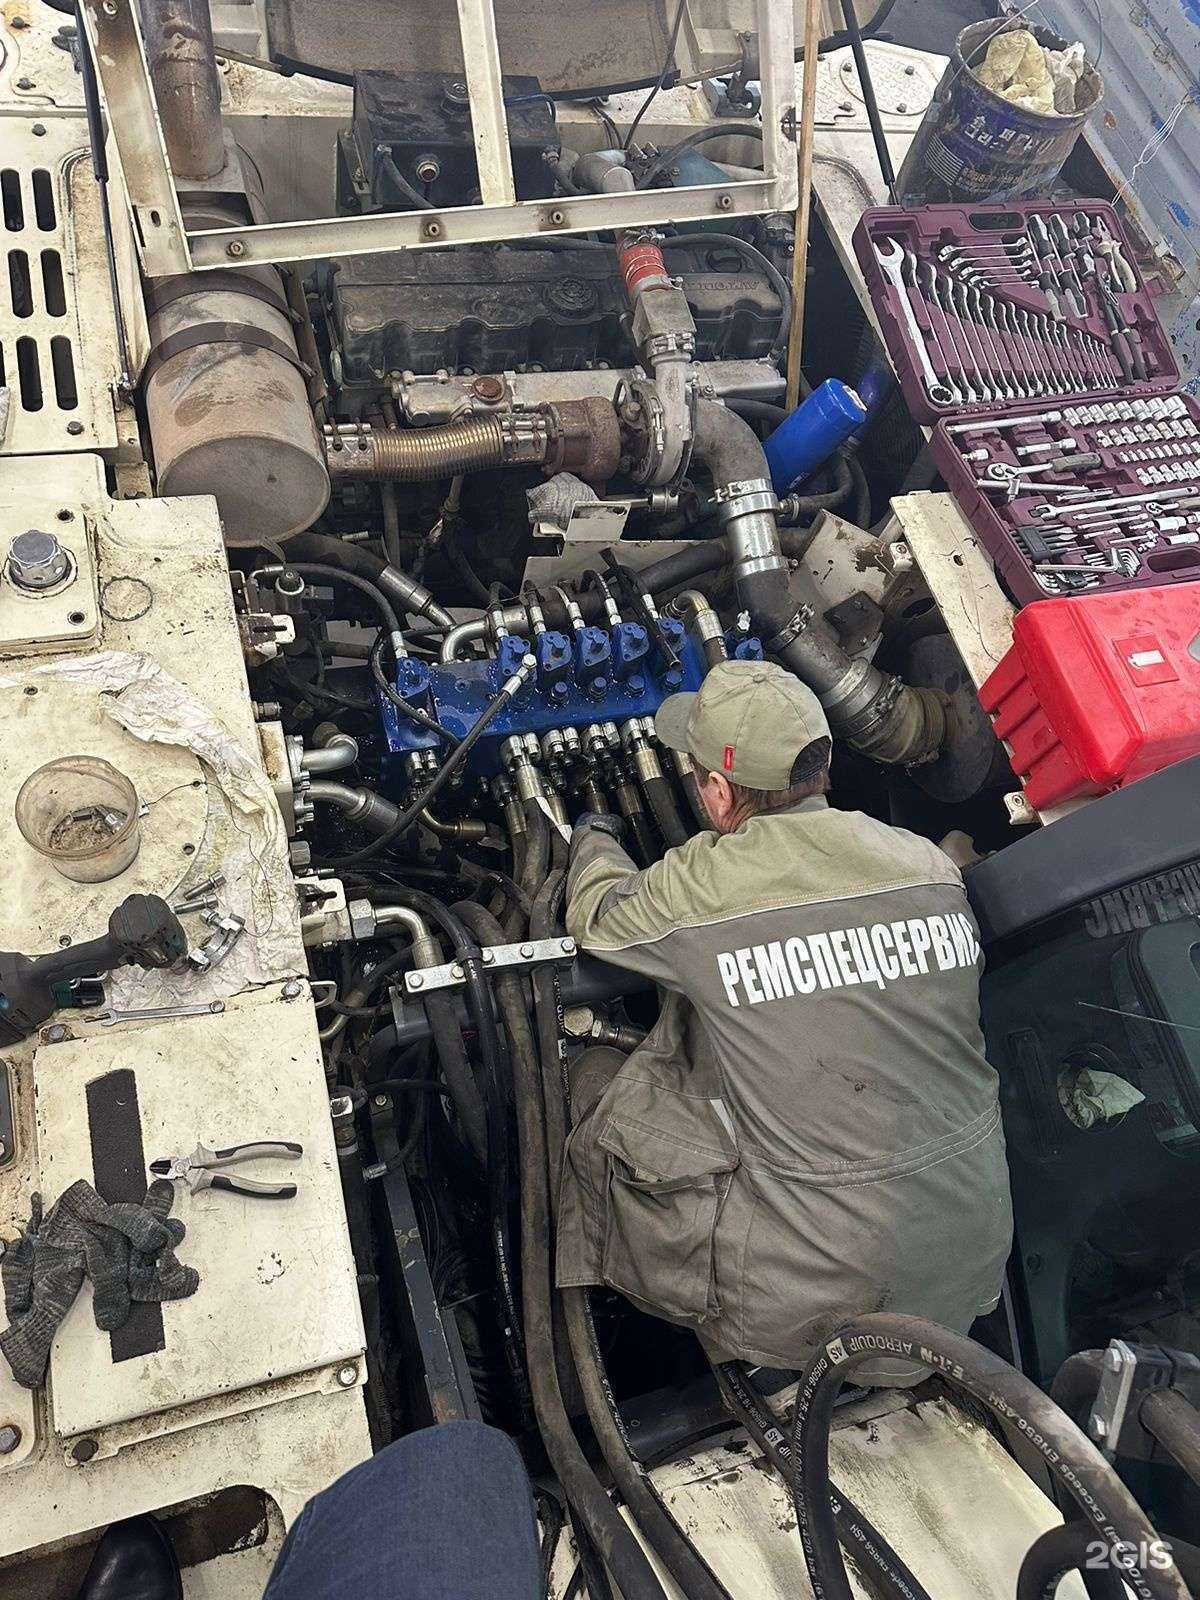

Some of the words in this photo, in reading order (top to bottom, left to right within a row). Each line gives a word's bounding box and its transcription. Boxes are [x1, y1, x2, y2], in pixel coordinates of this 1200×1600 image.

[716, 912, 981, 1008] РЕМСПЕЦСЕРВИС
[850, 1334, 913, 1354] AEROQUIP
[1016, 1418, 1060, 1464] EN856
[1059, 1463, 1106, 1522] Exceeds
